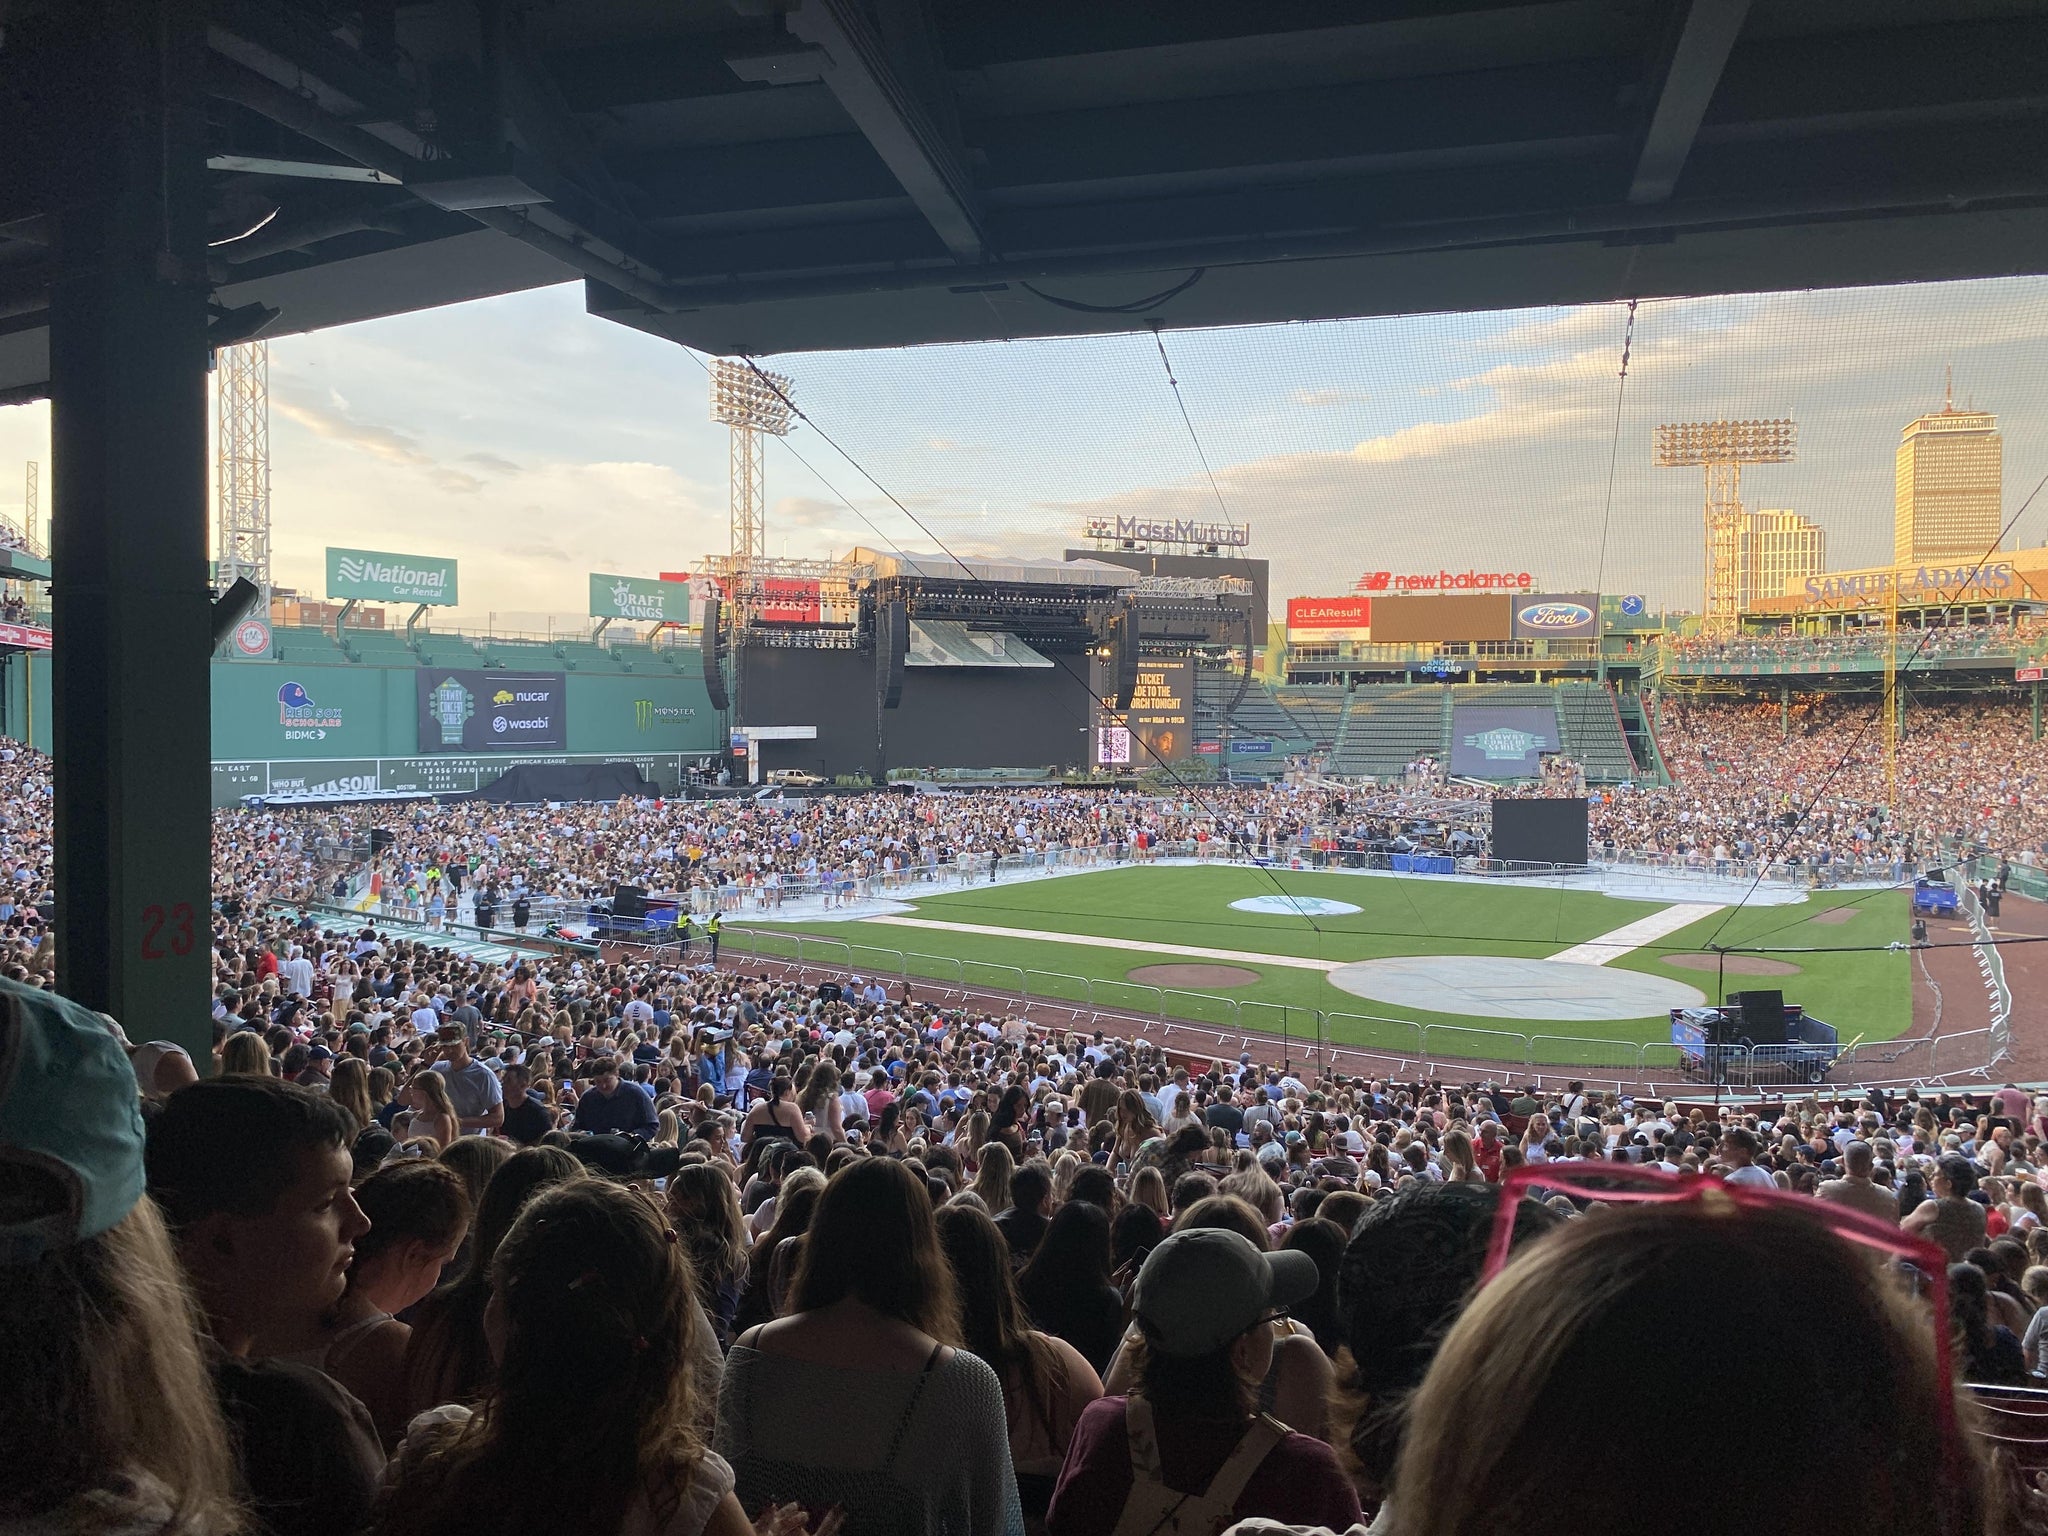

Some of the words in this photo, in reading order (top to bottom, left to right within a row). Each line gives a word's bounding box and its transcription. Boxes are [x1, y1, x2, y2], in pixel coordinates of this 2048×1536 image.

[1115, 514, 1249, 546] MassMutual
[1395, 574, 1437, 589] new
[1439, 569, 1531, 589] balance
[1912, 563, 2011, 590] ADAMS
[393, 586, 409, 595] Car
[412, 587, 442, 597] Rental
[613, 592, 664, 607] DRAFT
[621, 604, 663, 619] KINGS
[1295, 607, 1362, 618] CLEAResult
[1532, 605, 1577, 625] Ford
[1420, 665, 1462, 673] ORCHARD
[1140, 674, 1165, 684] TICKET
[516, 691, 549, 702] nucar
[1147, 686, 1156, 697] TO
[1157, 686, 1170, 697] THE
[1130, 698, 1150, 710] ORCH
[1150, 698, 1181, 710] TONIGHT
[286, 708, 312, 718] RED
[316, 708, 342, 718] SOX
[654, 706, 696, 716] MONSTER
[286, 718, 342, 726] SCHOLARS
[286, 730, 316, 740] BIDMC
[272, 780, 289, 788] WHO
[290, 780, 304, 788] BUT
[311, 776, 376, 794] MASON
[142, 902, 196, 960] 23
